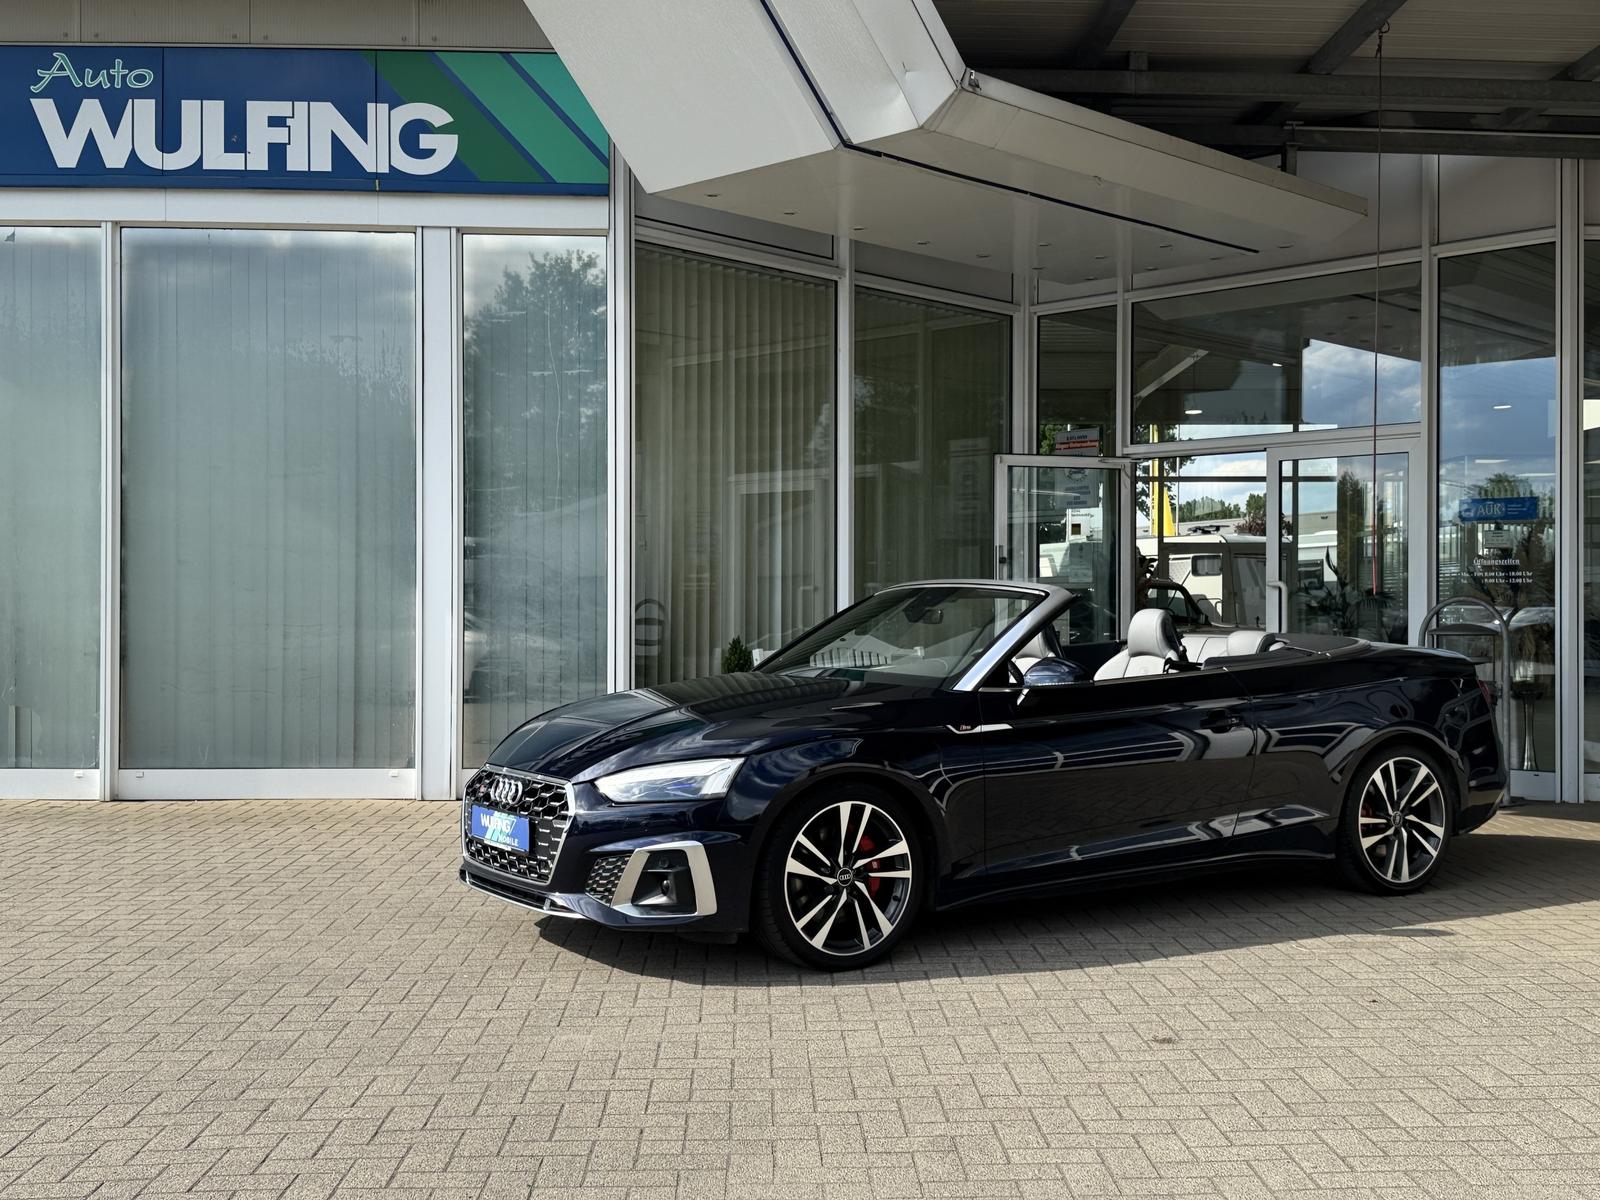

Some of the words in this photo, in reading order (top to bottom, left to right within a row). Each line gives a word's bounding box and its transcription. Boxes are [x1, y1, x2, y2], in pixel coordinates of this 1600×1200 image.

[30, 52, 154, 93] Auto
[29, 98, 459, 175] WULFING
[1473, 556, 1520, 566] Öffnungszeiten
